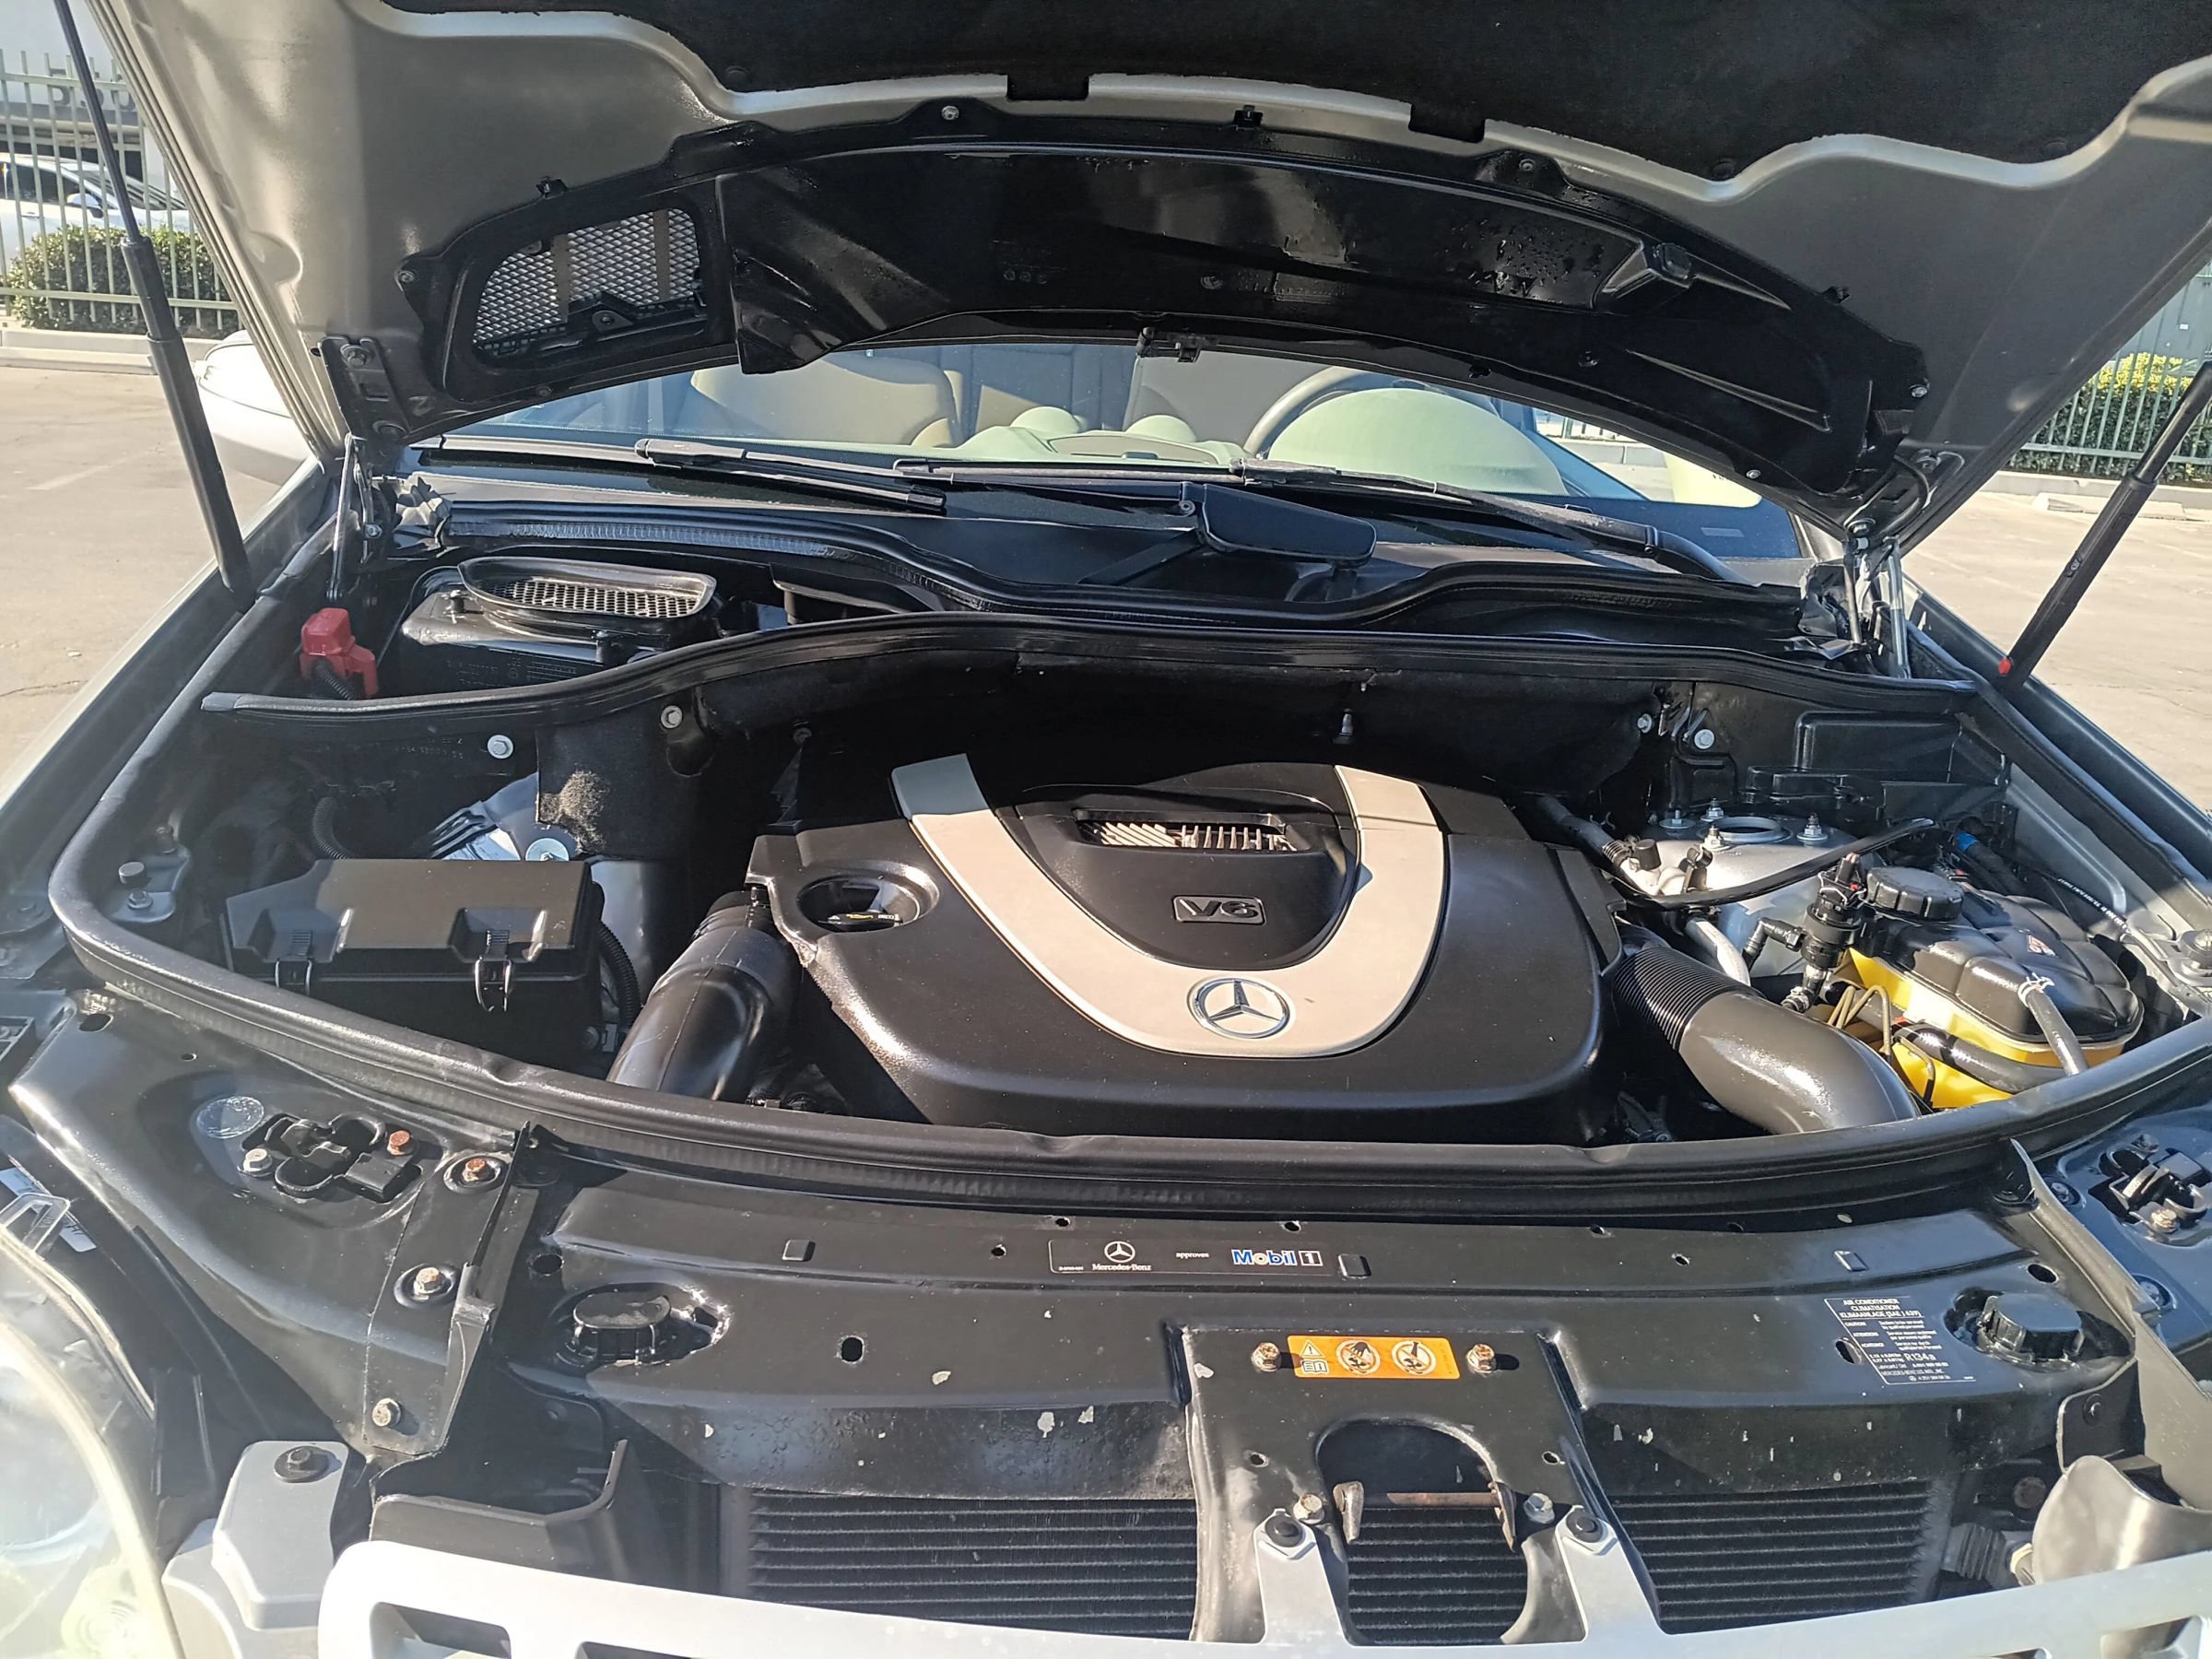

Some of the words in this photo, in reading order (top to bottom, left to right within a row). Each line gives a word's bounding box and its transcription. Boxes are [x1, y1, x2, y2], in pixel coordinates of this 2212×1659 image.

[1180, 899, 1259, 919] V6
[1230, 1249, 1298, 1266] Mobil
[1092, 1263, 1152, 1271] Mercedes-Benz
[1903, 1352, 1936, 1361] R134a
